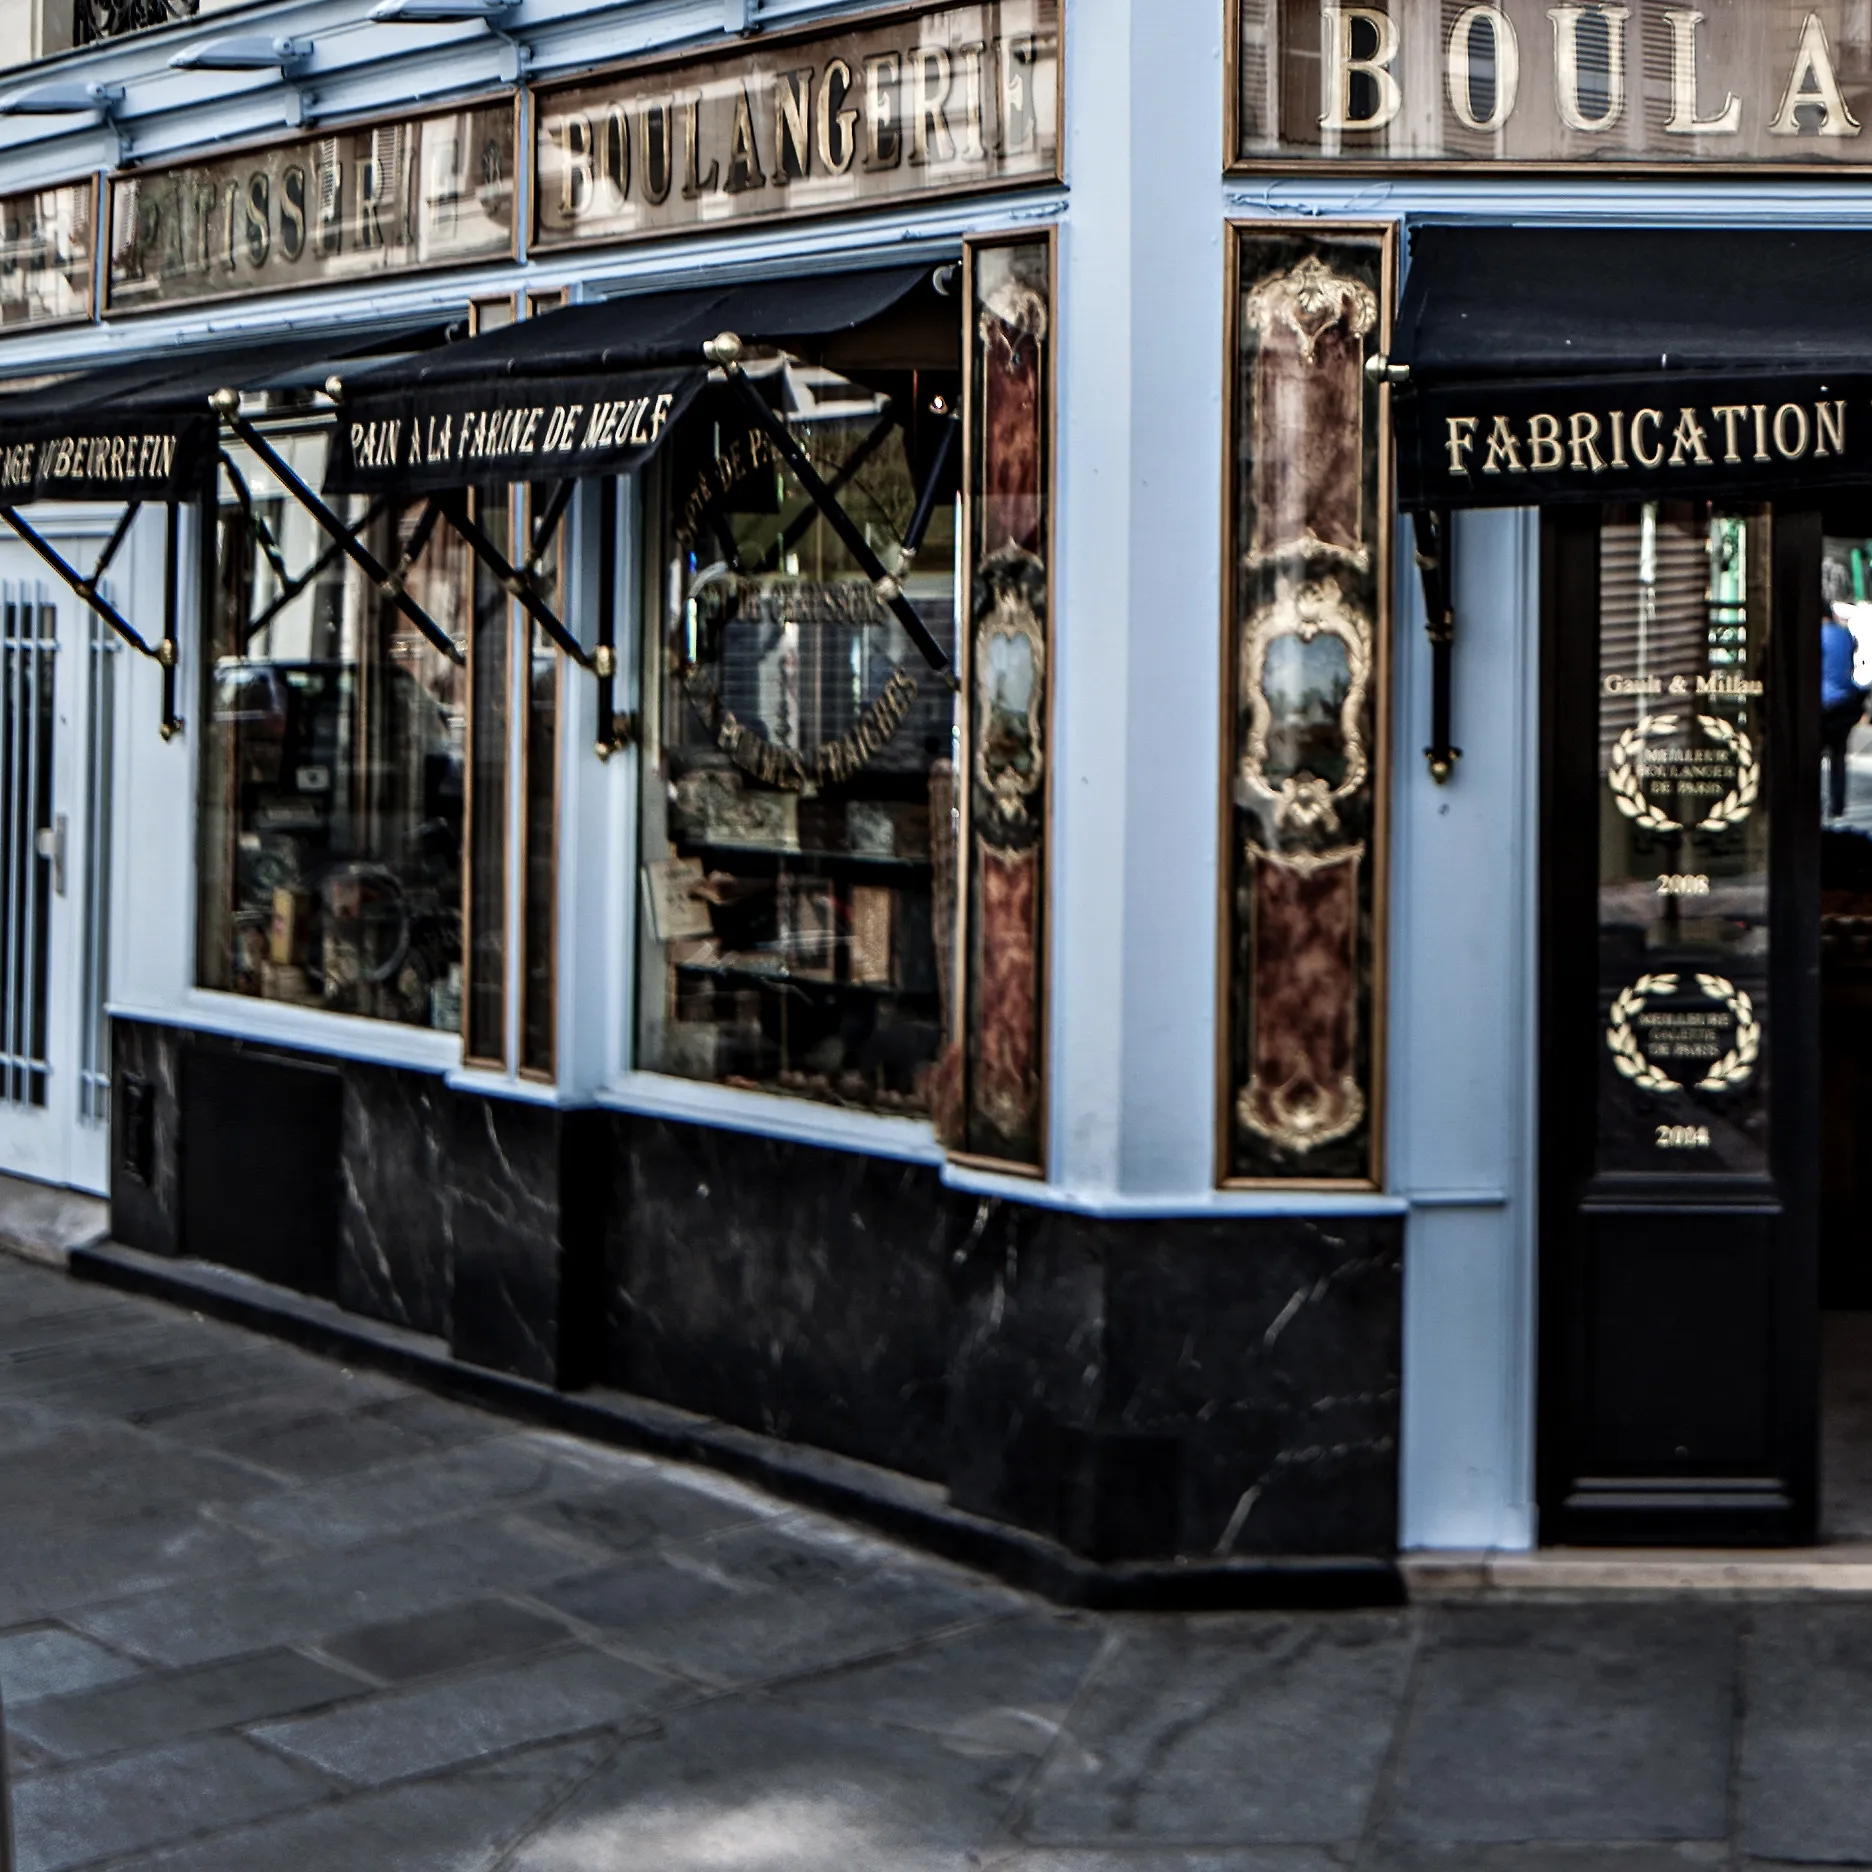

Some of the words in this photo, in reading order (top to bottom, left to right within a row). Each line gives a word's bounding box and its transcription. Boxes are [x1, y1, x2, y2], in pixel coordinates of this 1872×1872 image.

[556, 35, 1038, 219] BOULANGERIE
[53, 435, 138, 482] BEURRE
[139, 434, 177, 479] FIN
[351, 419, 400, 468] PAIN
[427, 413, 452, 463] LA
[457, 407, 545, 461] FARINE
[541, 404, 584, 454] DE
[1443, 397, 1846, 476] FABRICATION
[1668, 674, 1688, 694] &
[1696, 673, 1764, 696] Millau
